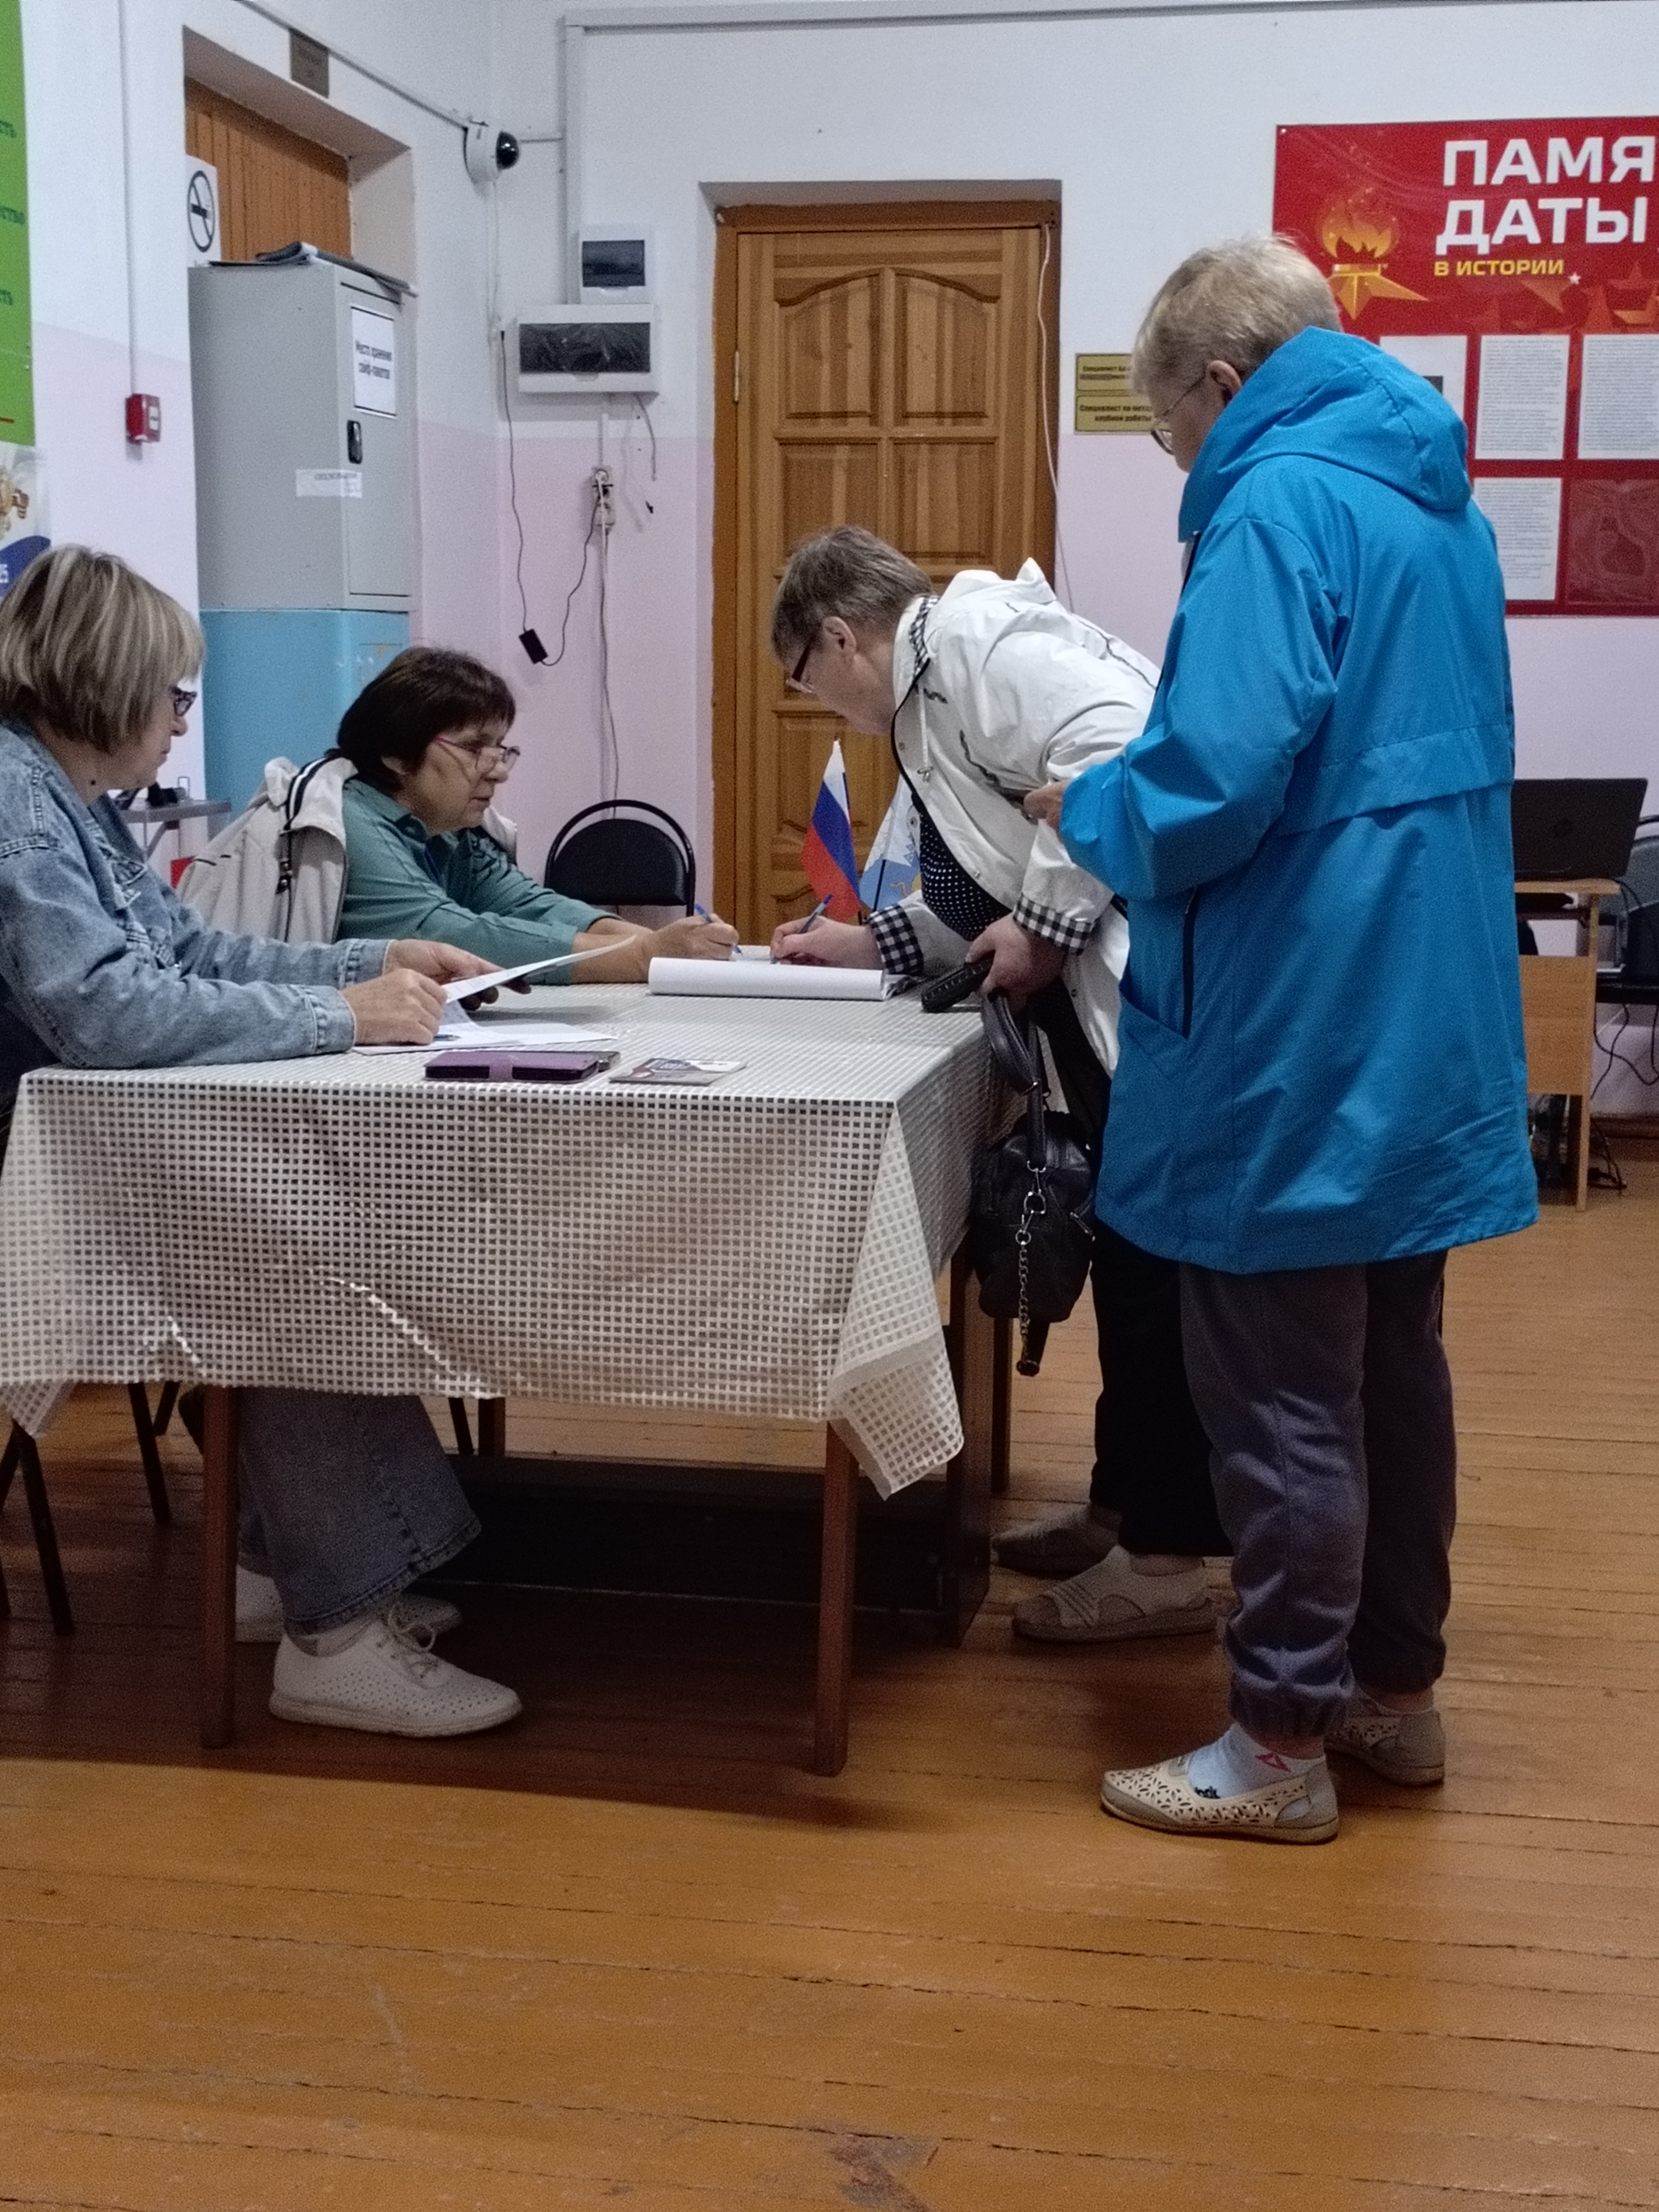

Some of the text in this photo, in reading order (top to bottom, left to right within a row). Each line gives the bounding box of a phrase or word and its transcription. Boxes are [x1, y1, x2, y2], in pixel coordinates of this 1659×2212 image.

[1443, 136, 1656, 186] ПАМЯ
[1435, 197, 1648, 255] ДАТЫ
[1434, 259, 1564, 276] В ИСТОРИИ
